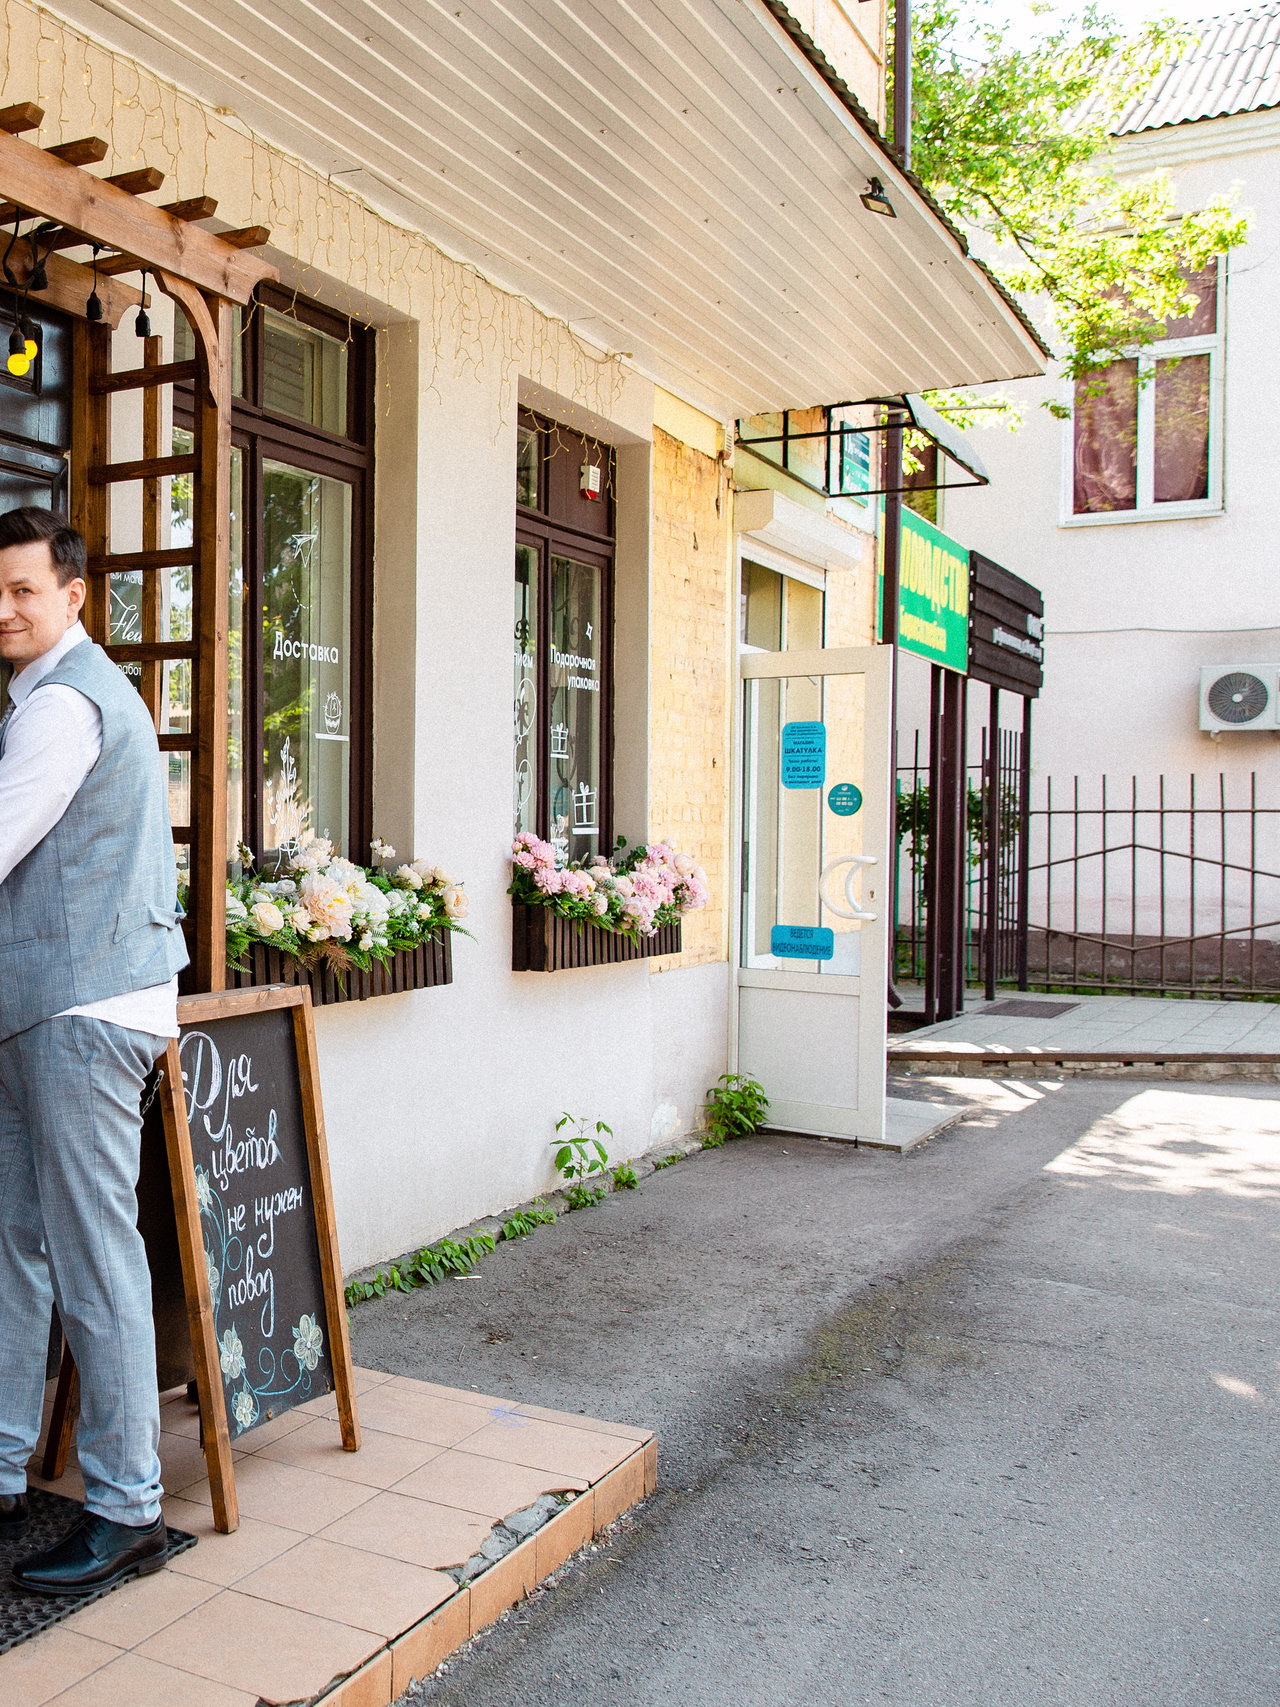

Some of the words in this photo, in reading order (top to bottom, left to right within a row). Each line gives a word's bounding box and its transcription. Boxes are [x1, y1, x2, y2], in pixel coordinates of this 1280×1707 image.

[110, 589, 142, 642] Fleu
[273, 630, 339, 664] Доставка
[550, 645, 596, 671] Подарочная
[567, 676, 600, 692] упаковка
[179, 1031, 260, 1142] Для
[212, 1108, 279, 1191] цветов
[227, 1203, 247, 1236] не
[254, 1186, 303, 1259] нужен
[228, 1245, 275, 1338] повод
